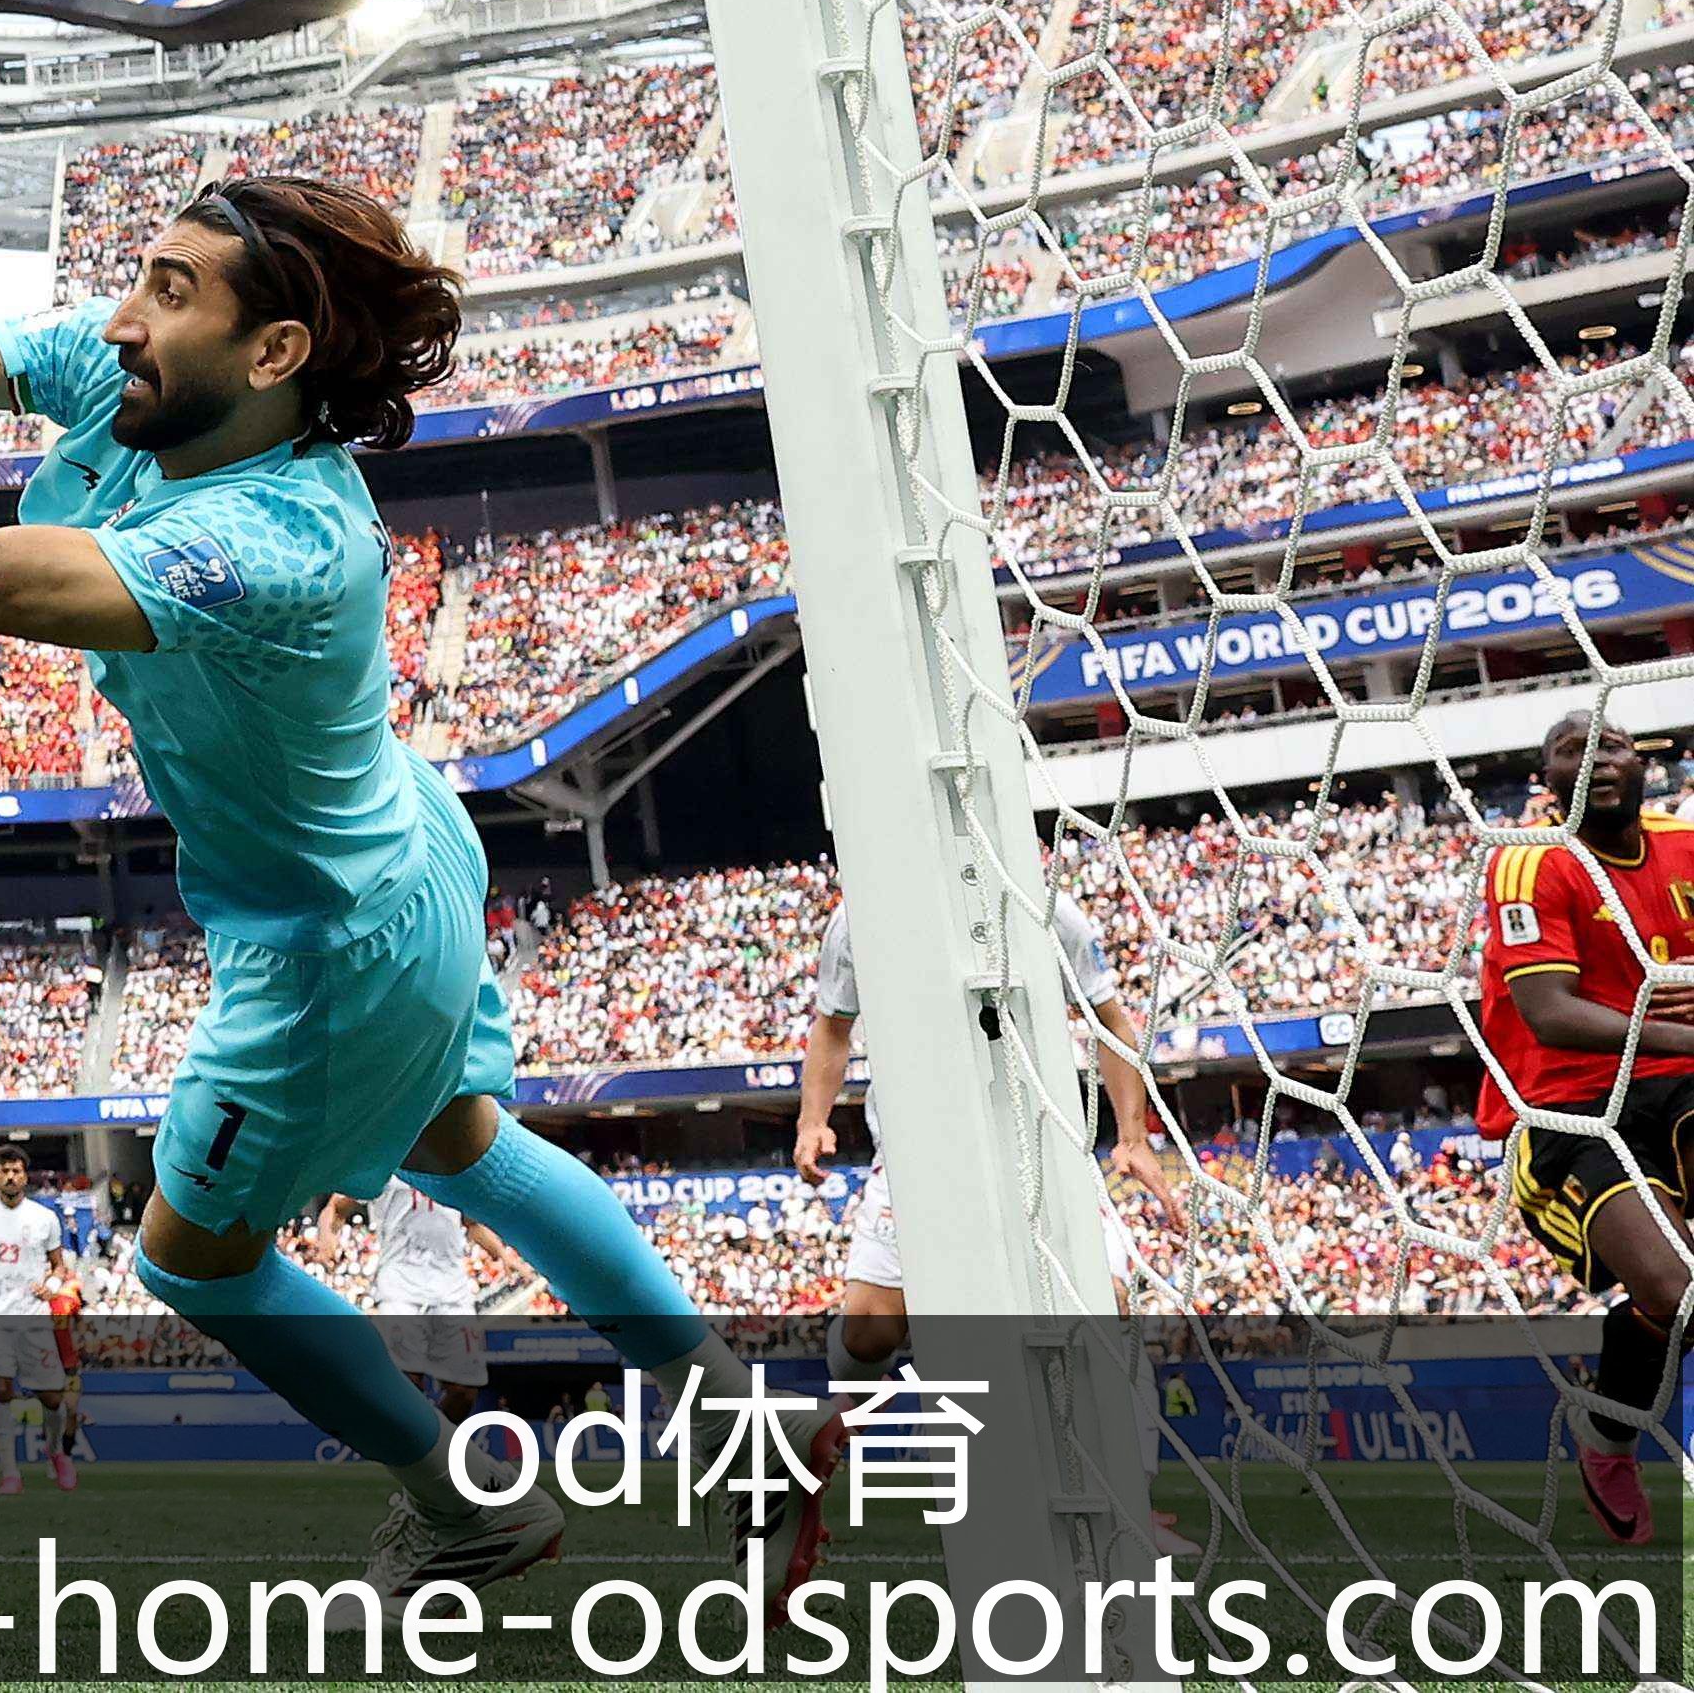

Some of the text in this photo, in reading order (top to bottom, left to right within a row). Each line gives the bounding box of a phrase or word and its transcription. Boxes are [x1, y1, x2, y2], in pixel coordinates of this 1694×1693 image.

[1081, 569, 1622, 687] FIFA WORLD CUP 2026
[672, 1177, 734, 1203] CUP
[1352, 1409, 1477, 1461] ULTRA
